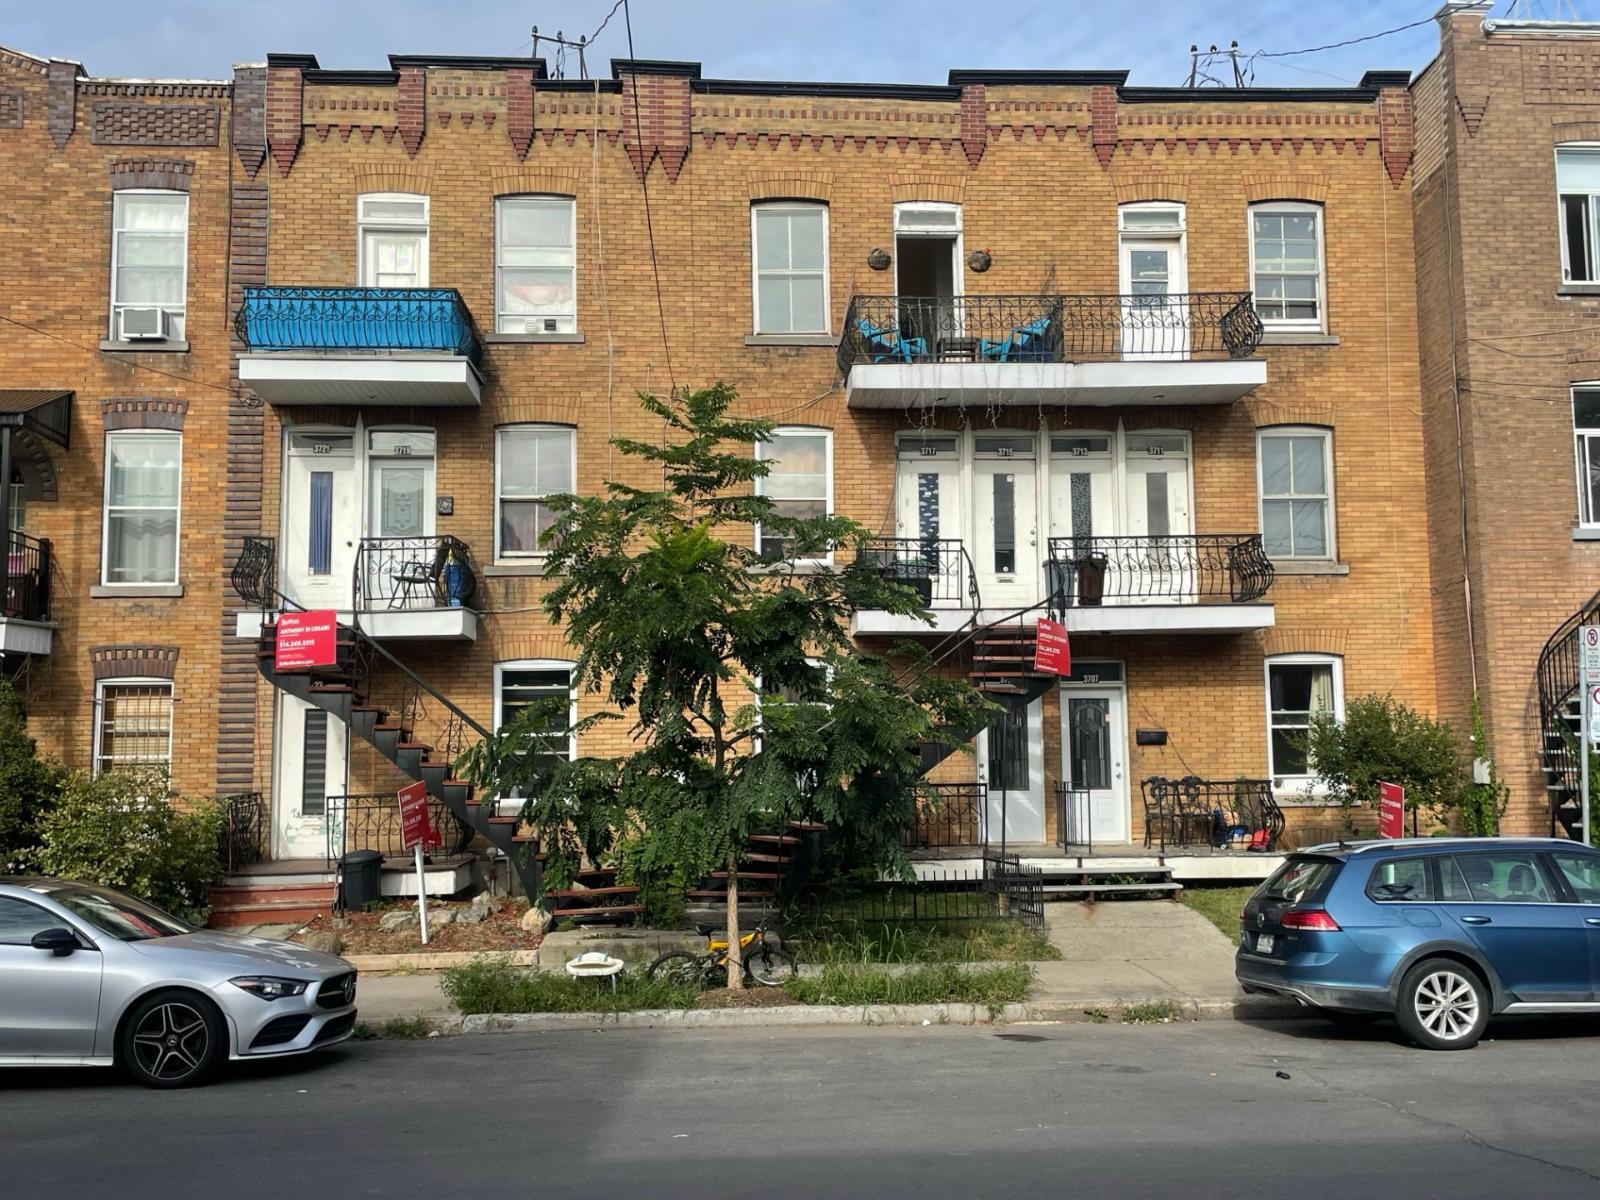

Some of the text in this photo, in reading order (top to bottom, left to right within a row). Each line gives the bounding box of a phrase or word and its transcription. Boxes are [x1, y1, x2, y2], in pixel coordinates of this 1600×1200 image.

[921, 447, 936, 456] 3717
[998, 447, 1014, 456] 3715
[1149, 446, 1164, 455] 3711
[1083, 674, 1099, 683] 3707
